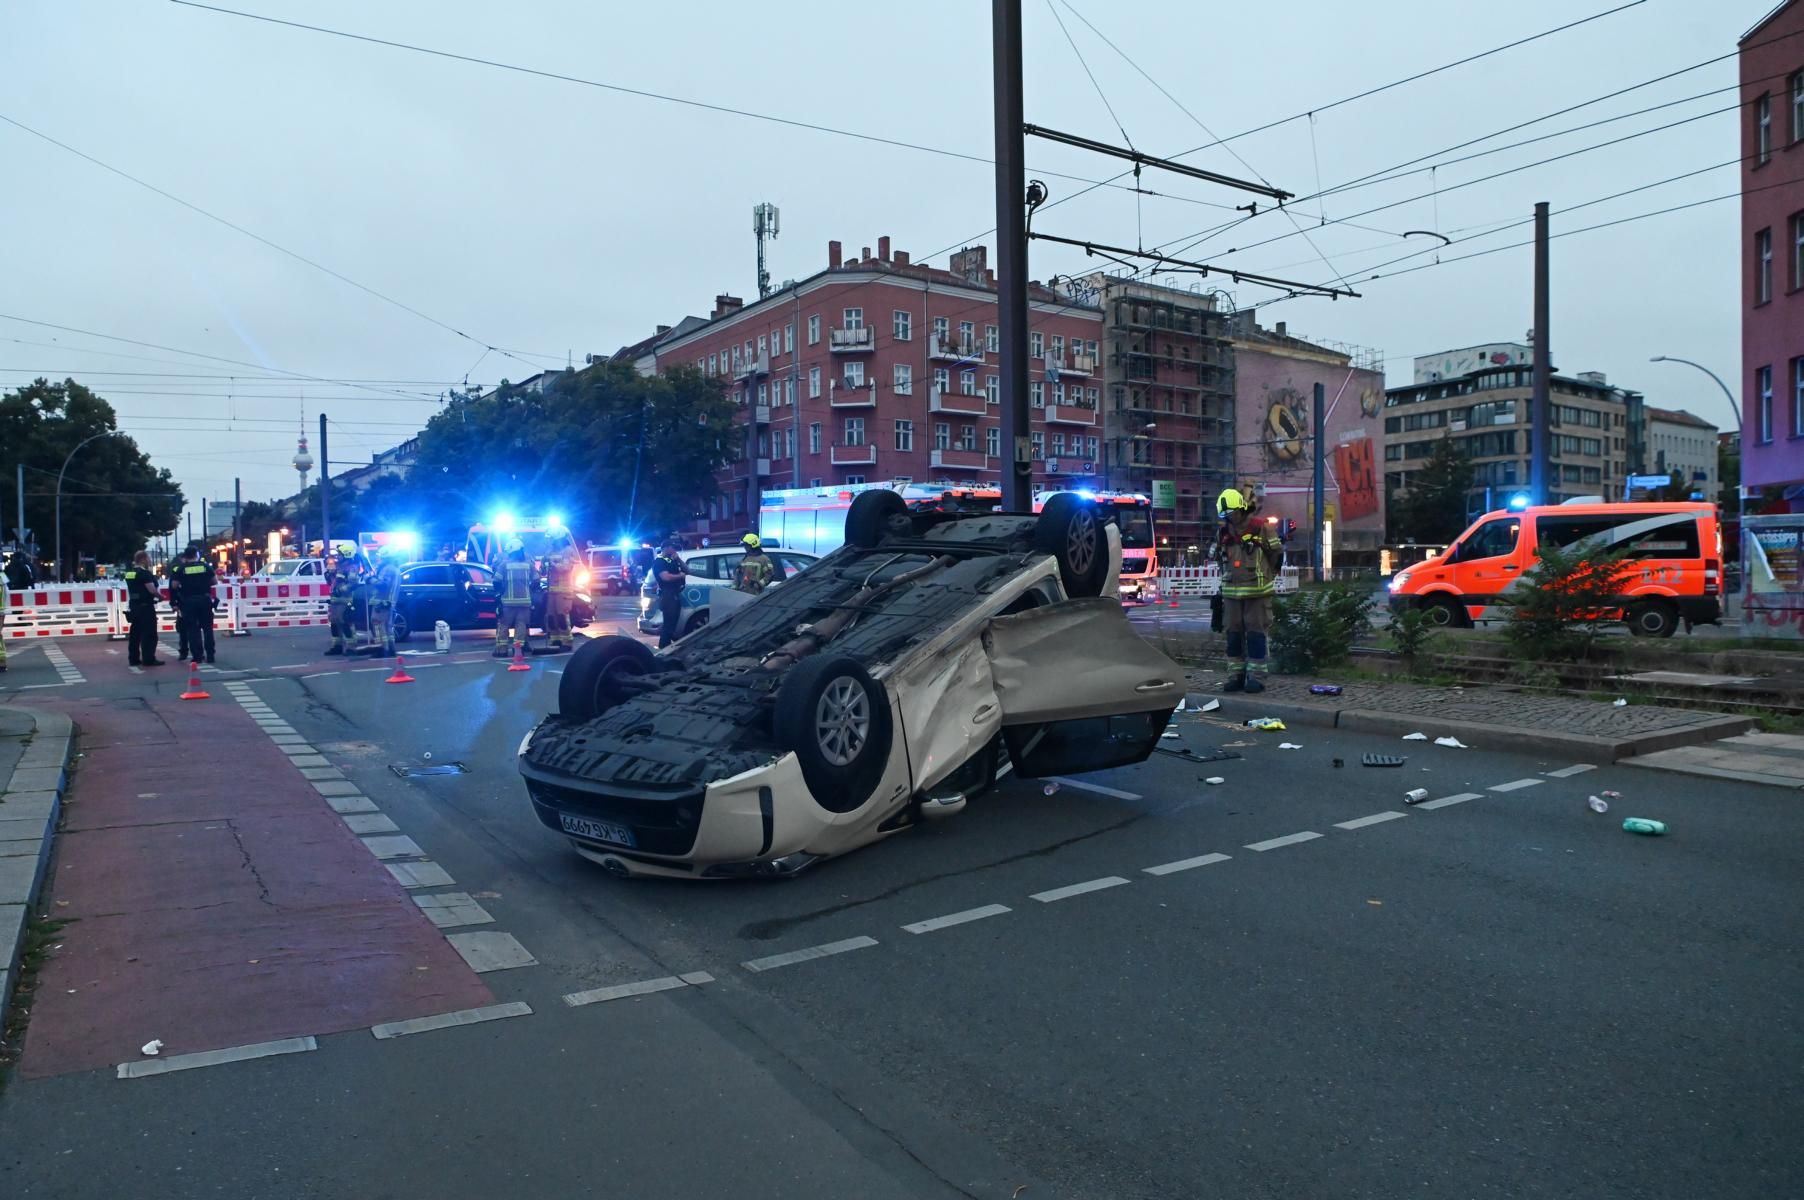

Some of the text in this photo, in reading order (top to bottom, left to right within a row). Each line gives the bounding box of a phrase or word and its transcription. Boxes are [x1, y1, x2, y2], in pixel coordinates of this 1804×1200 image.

[1641, 566, 1682, 584] 112
[563, 816, 627, 843] B KG 4999
